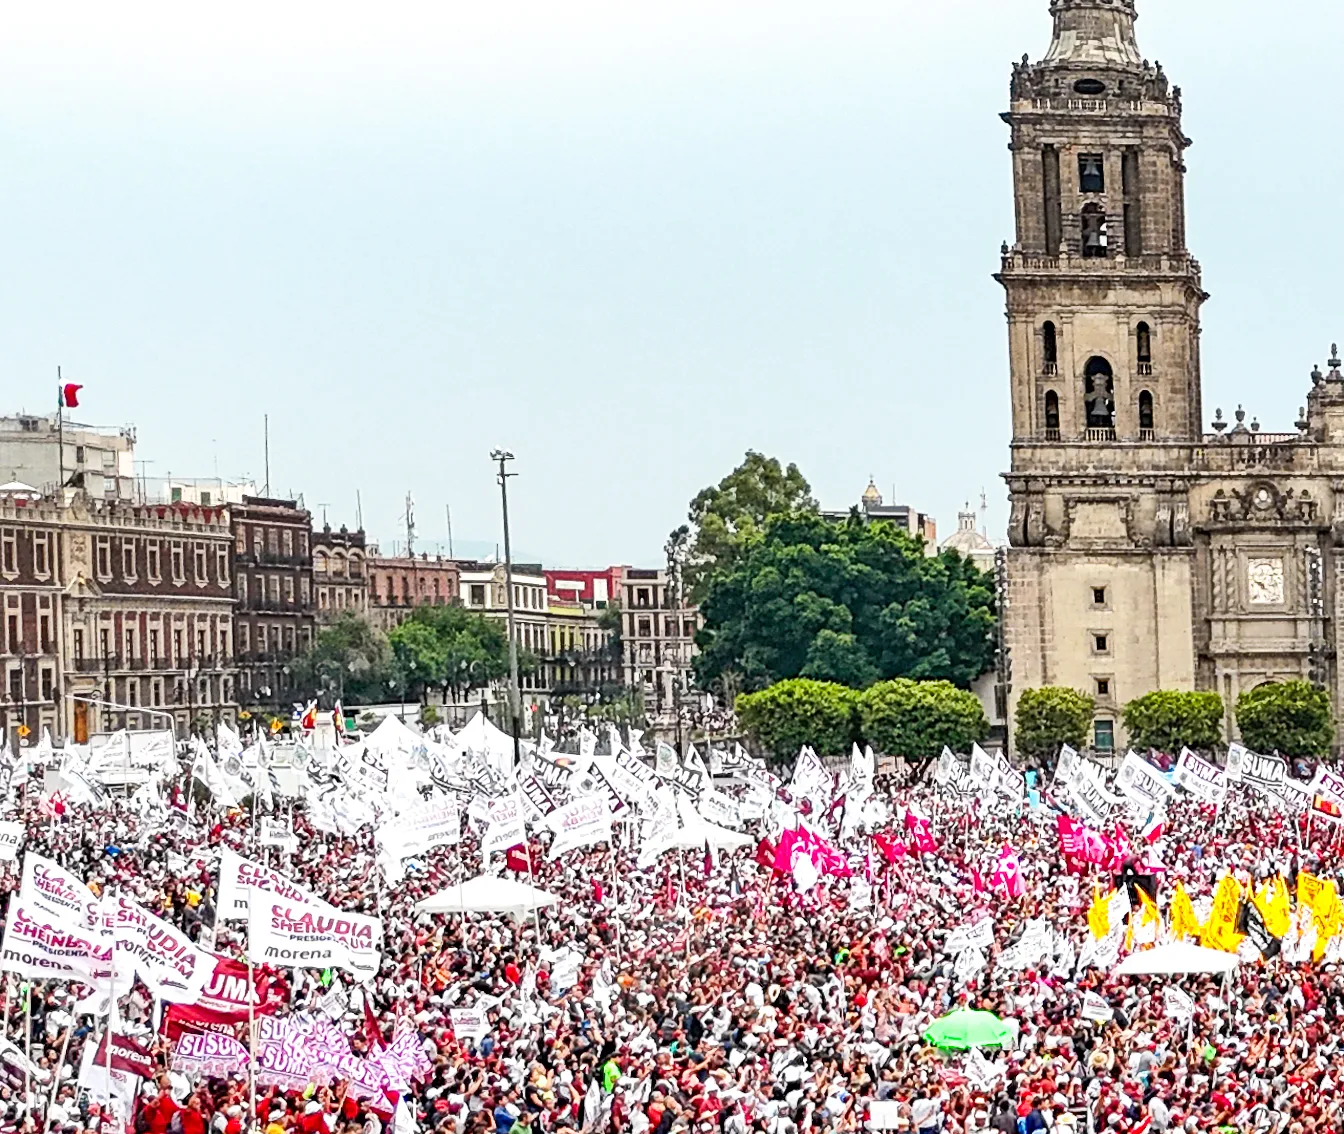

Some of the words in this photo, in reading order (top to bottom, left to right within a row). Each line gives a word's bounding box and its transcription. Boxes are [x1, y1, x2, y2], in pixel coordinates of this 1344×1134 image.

[1186, 754, 1225, 787] SUMA
[1243, 754, 1284, 781] SUMA
[271, 904, 373, 940] CLAUDIA
[3, 949, 73, 972] morena
[264, 945, 332, 961] morena
